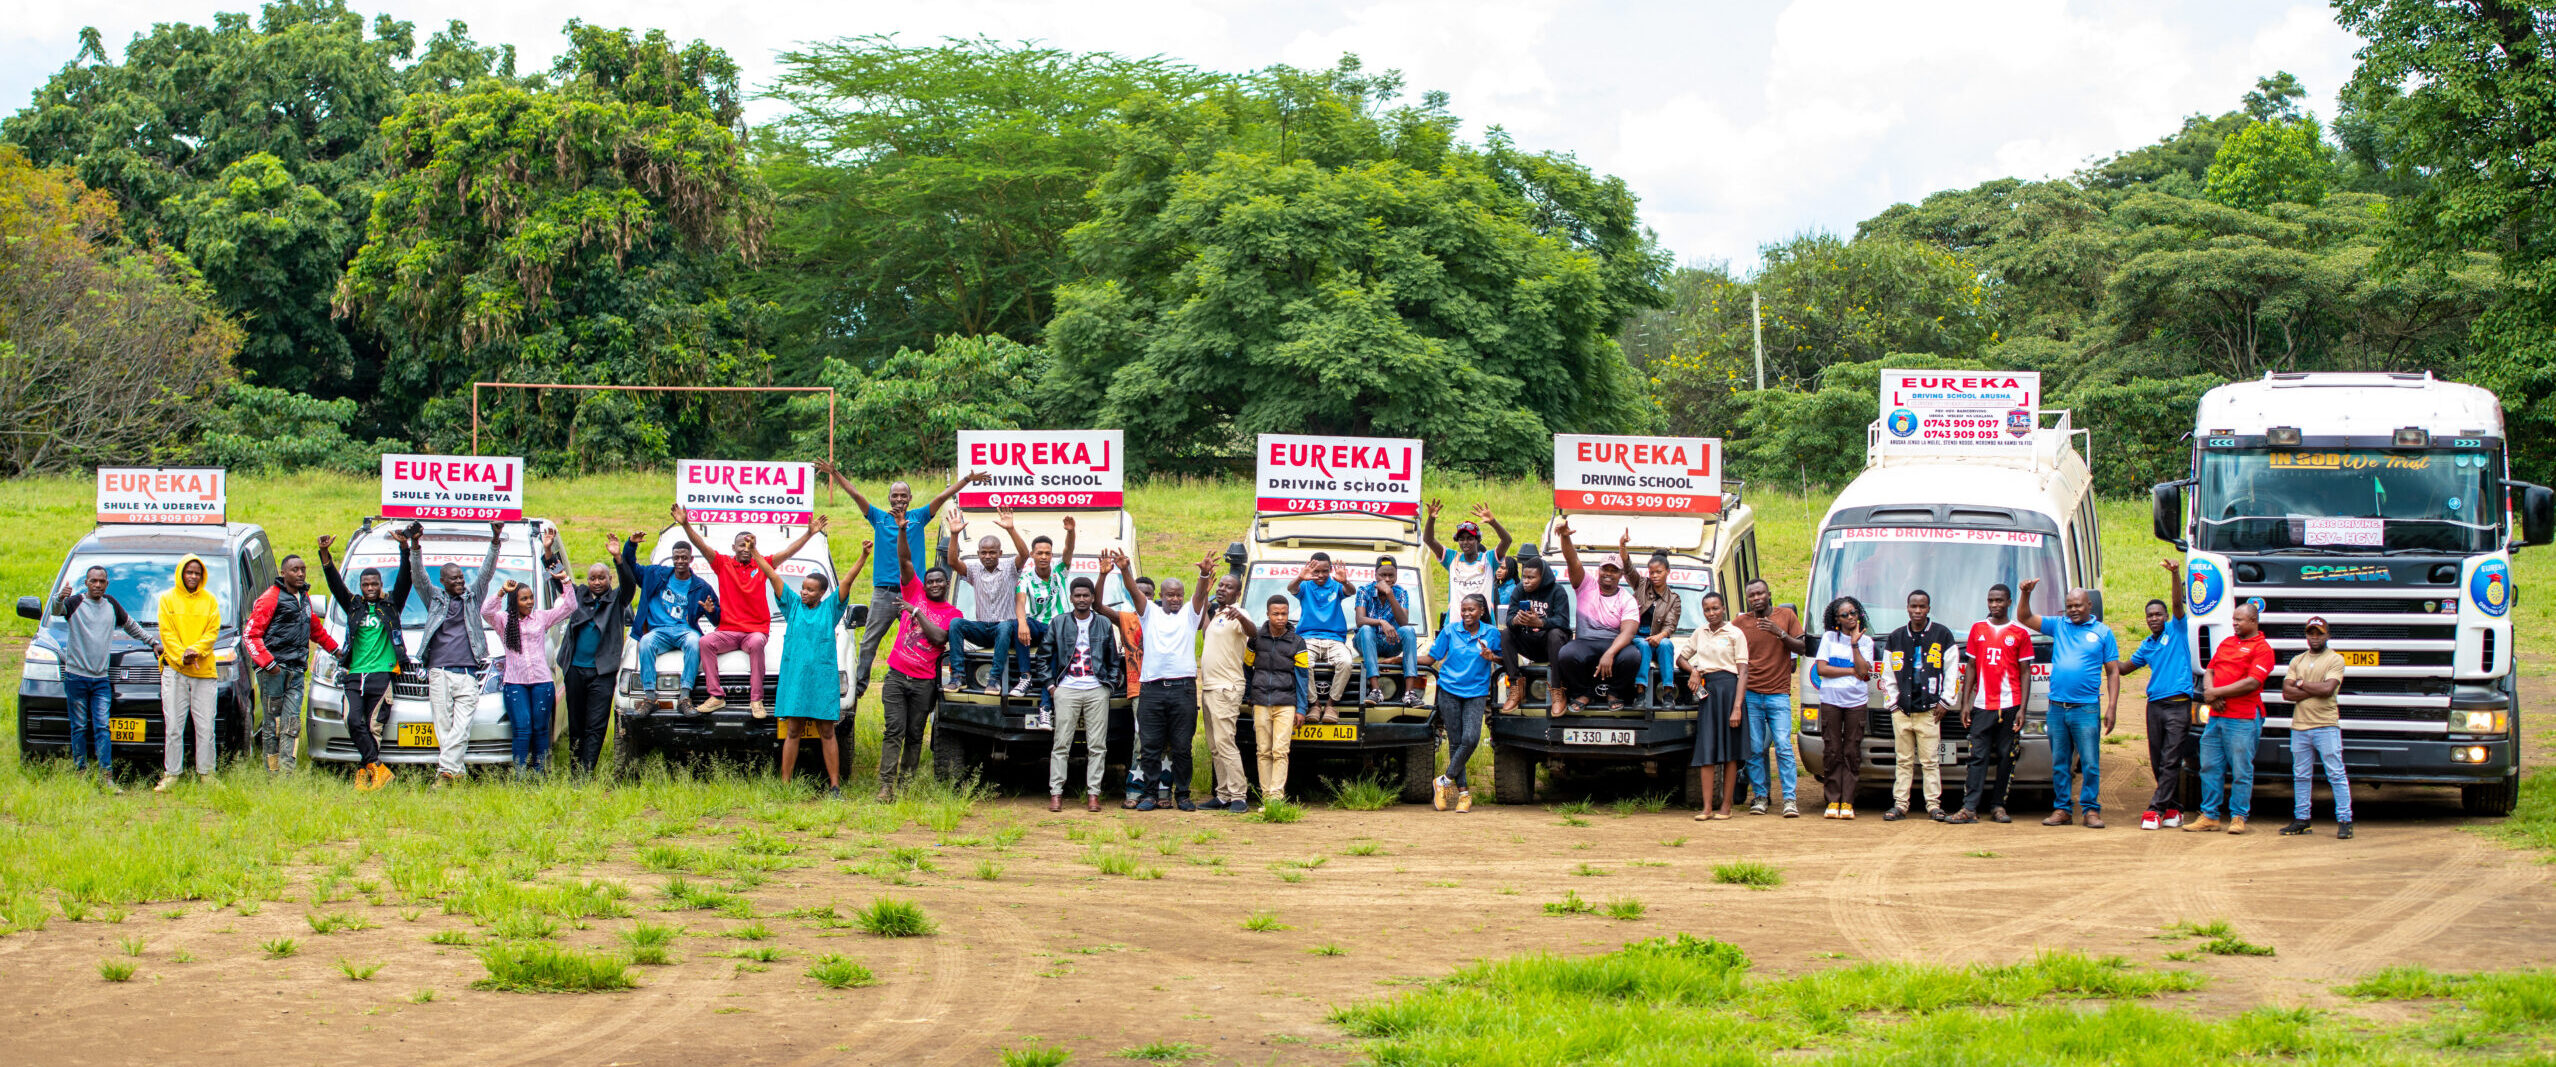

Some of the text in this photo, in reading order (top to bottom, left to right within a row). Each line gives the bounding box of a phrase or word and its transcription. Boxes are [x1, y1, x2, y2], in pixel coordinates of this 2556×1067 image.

[1902, 378, 2019, 392] EUREKA
[1924, 419, 1999, 428] 0743 909 097
[1924, 430, 1950, 439] 0743
[1953, 430, 1975, 439] 909
[1978, 430, 1999, 439] 093
[971, 442, 1092, 475] EUREKA
[1270, 443, 1391, 478] EUREKA
[1578, 442, 1688, 473] EUREKA
[2269, 452, 2432, 470] IN GOD We Trust
[395, 461, 497, 491] EUREKA
[689, 465, 788, 493] EUREKA
[1041, 475, 1102, 486] SCHOOL
[1581, 474, 1693, 489] DRIVING SCHOOL
[106, 474, 202, 501] EUREKA
[1269, 479, 1409, 493] DRIVING SCHOOL
[392, 491, 511, 502] SHULE YA UDEREVA
[688, 494, 803, 505] DRIVING SCHOOL
[1003, 494, 1093, 505] 0743 909 097
[1601, 494, 1691, 509] 0743 909 097
[104, 502, 139, 510] SHULE
[1288, 500, 1390, 513] 0743 909 097
[129, 514, 206, 523] 0743 909 097
[415, 507, 502, 519] 0743 909 097
[701, 511, 799, 524] 0743 909 097
[2307, 519, 2336, 528] BASIC
[1846, 528, 1888, 538] BASIC
[2008, 533, 2038, 544] HGV
[2300, 565, 2392, 582] SCANIA
[2353, 653, 2375, 665] DMS
[116, 731, 134, 740] BXQ
[1304, 727, 1322, 738] 676
[1333, 727, 1353, 739] ALD
[1582, 731, 1601, 743] 330
[1611, 732, 1630, 744] AJQ
